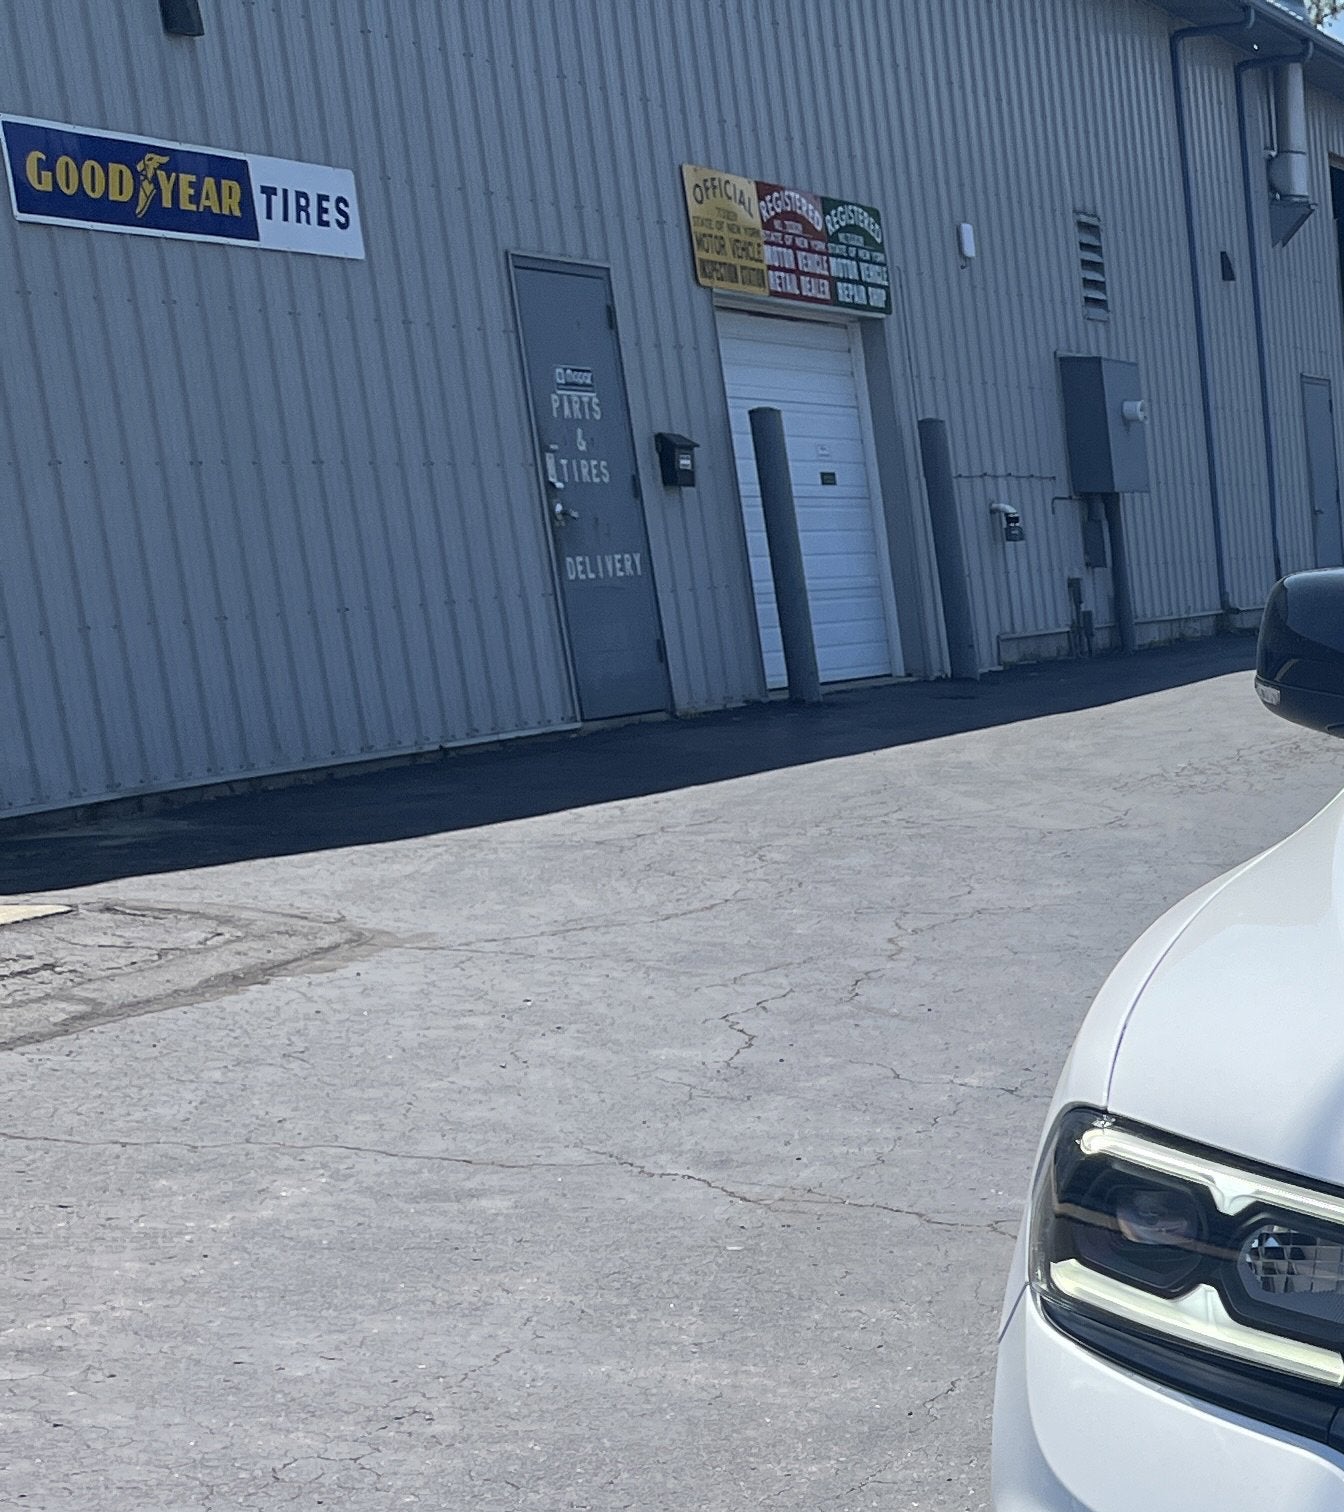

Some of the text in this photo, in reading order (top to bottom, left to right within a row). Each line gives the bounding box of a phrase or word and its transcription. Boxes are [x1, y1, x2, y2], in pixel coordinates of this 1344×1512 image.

[260, 185, 350, 230] TIRES
[693, 177, 754, 219] OFFICIAL
[760, 189, 823, 232] REGISTERED
[825, 204, 881, 243] REGISTERED
[694, 231, 763, 263] MOTOR VEHICLE
[551, 394, 601, 420] PARTS
[576, 427, 587, 451] &
[560, 459, 610, 483] TIRES
[566, 553, 642, 580] DELIVERY
